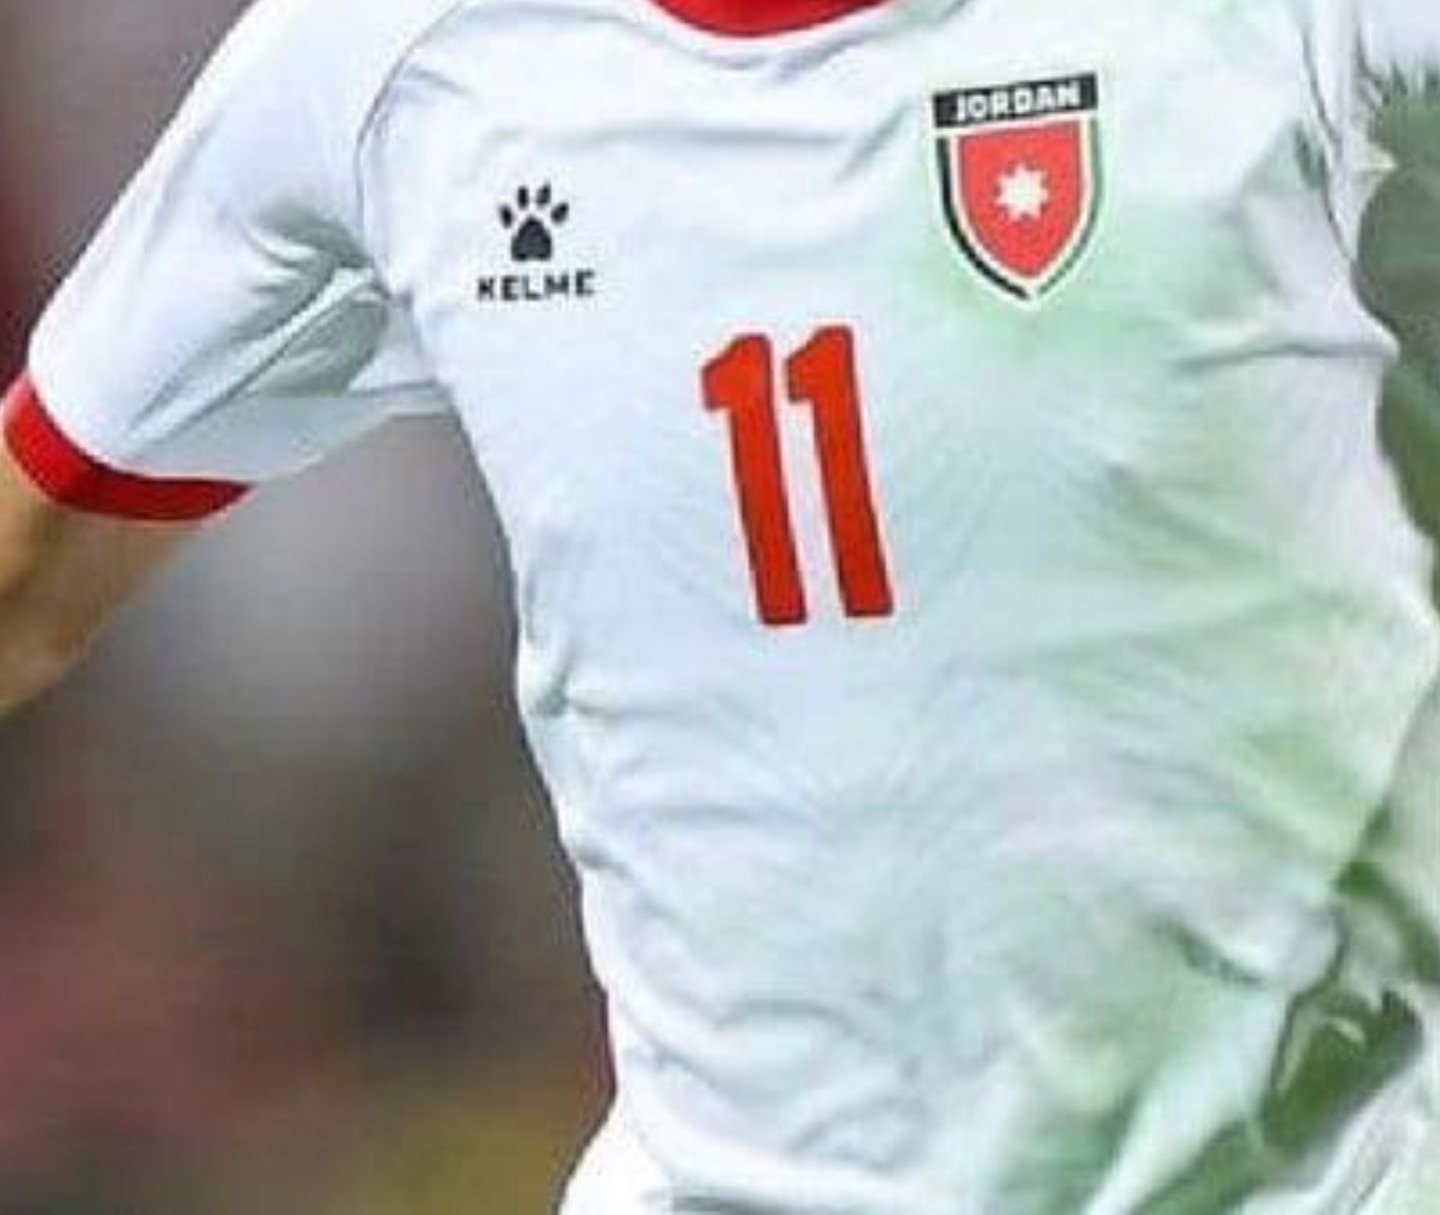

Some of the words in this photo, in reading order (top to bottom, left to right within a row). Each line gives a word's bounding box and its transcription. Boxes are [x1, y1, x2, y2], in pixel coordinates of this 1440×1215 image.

[957, 81, 1081, 121] JORDAN
[477, 269, 595, 301] KELME
[701, 325, 894, 625] 11
